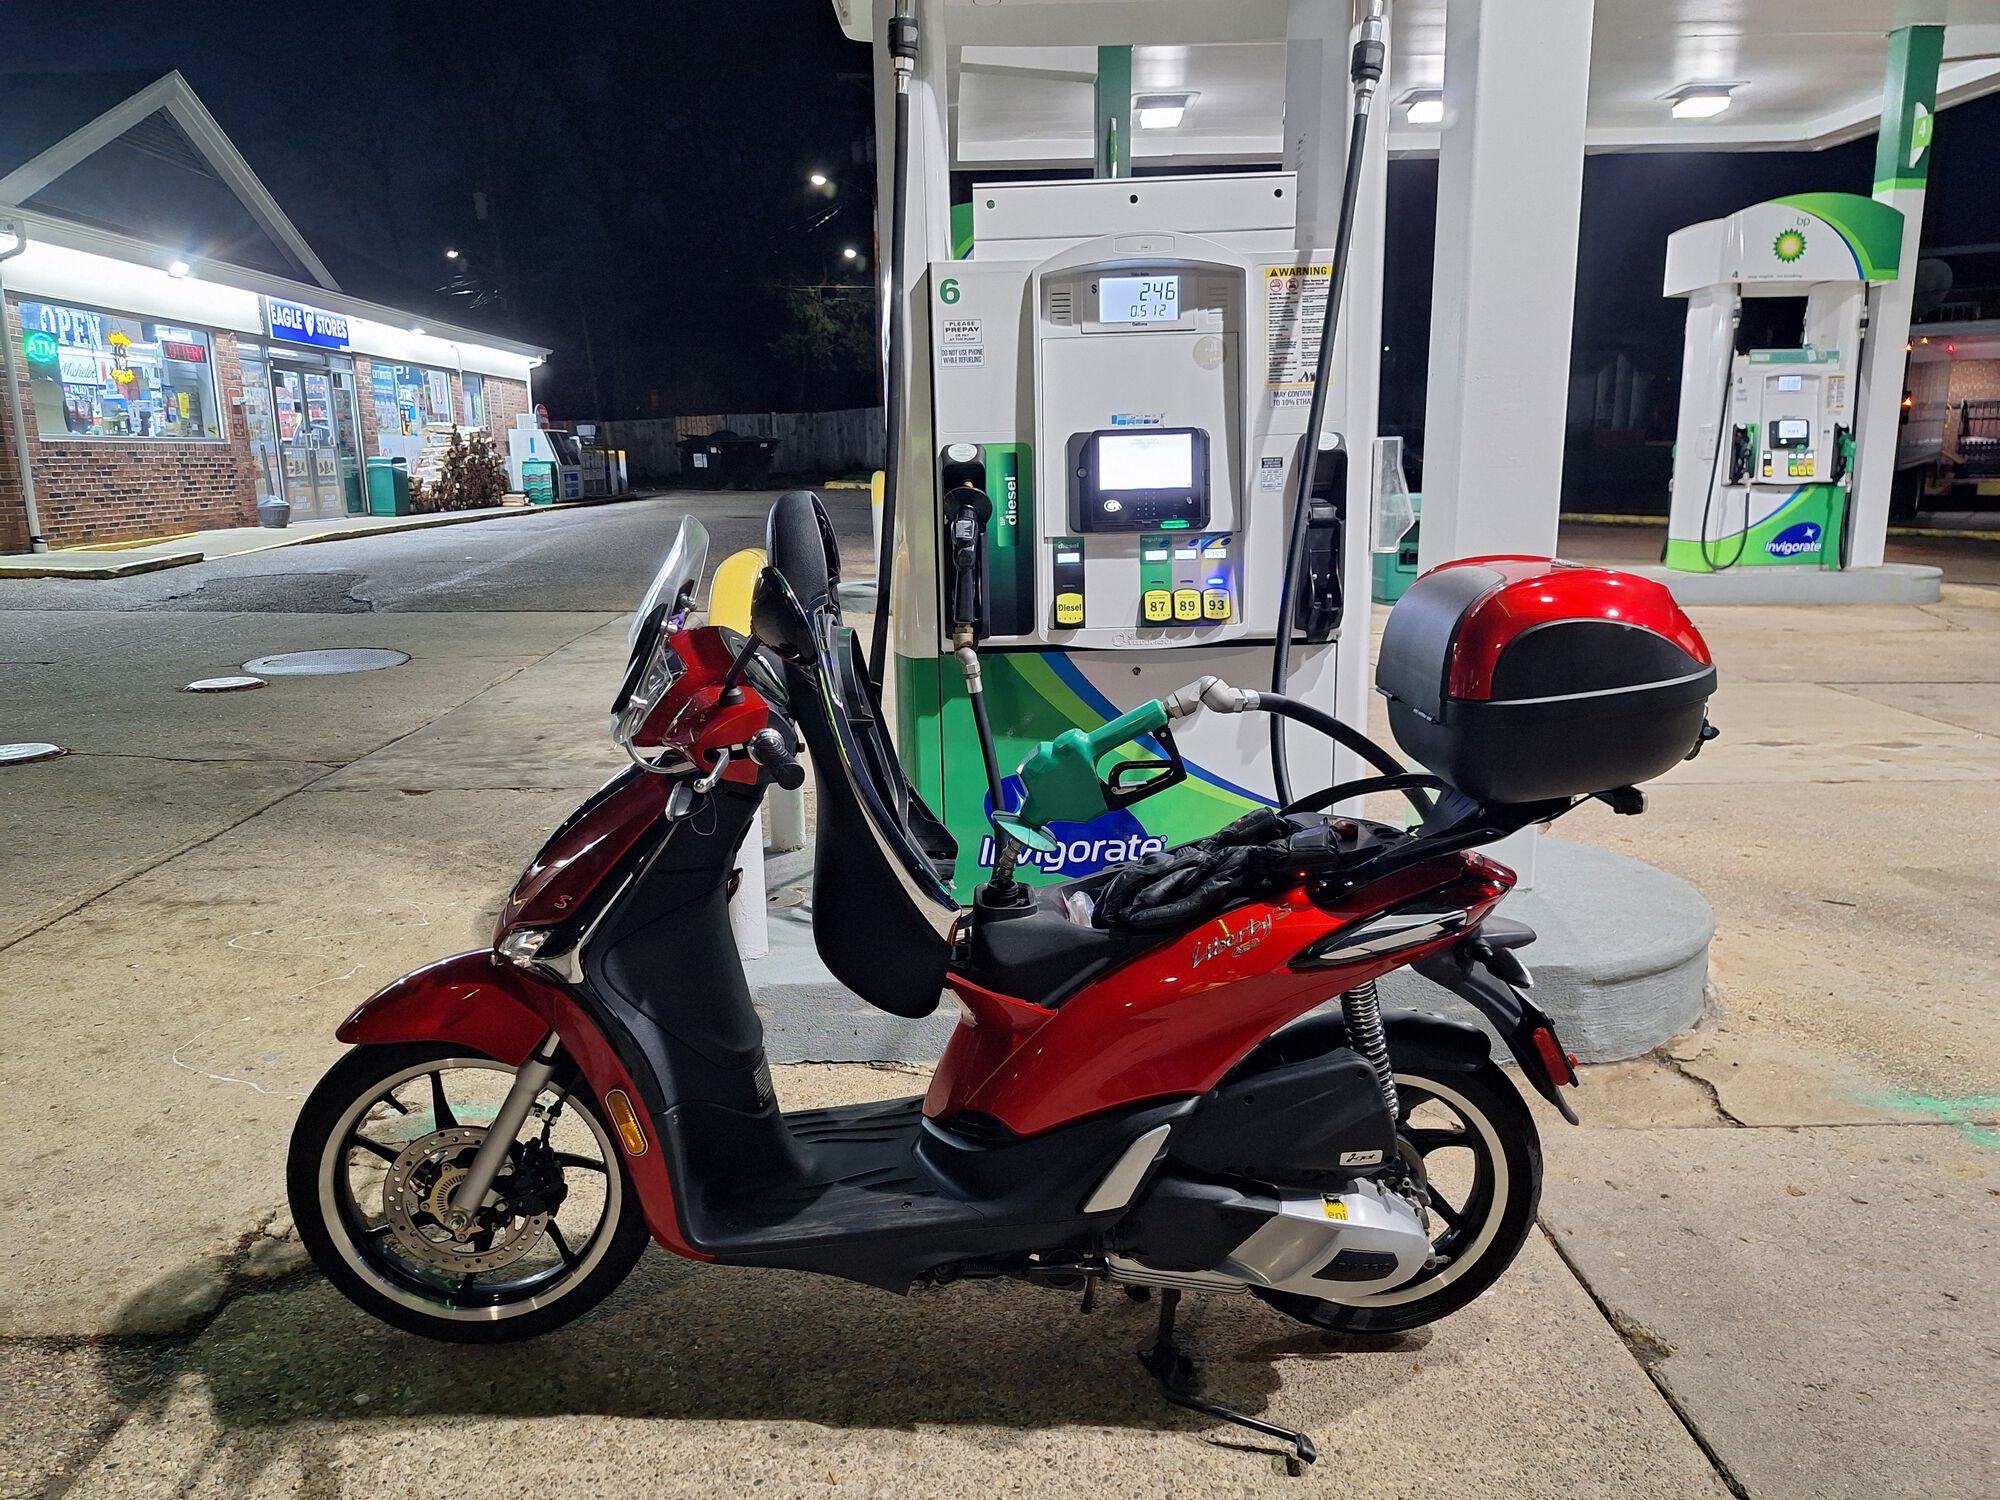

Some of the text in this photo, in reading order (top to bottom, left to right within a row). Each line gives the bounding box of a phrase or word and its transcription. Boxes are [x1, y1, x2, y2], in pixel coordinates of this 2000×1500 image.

[1918, 120, 1927, 138] 4
[1796, 216, 1811, 227] bp
[1278, 266, 1328, 277] WARNING
[1731, 270, 1739, 279] 4
[939, 278, 961, 305] 6
[1090, 284, 1098, 295] $
[1130, 303, 1167, 318] 0.512
[39, 304, 104, 350] OPEN
[270, 304, 347, 339] EAGLE STORES
[27, 340, 58, 357] ATM
[164, 341, 205, 362] LOTTERY
[949, 349, 958, 357] NOT
[968, 348, 983, 356] PHONE
[958, 356, 982, 364] REFUELING
[1287, 390, 1312, 398] CONTAIN
[1273, 399, 1281, 407] TO
[1296, 398, 1311, 406] ETHA
[1004, 476, 1017, 526] diesel
[1765, 541, 1822, 555] Invigorate
[1058, 603, 1082, 612] Diesel
[1150, 602, 1166, 612] 87
[1179, 600, 1196, 611] 89
[1208, 600, 1225, 611] 93
[554, 894, 573, 909] S
[1192, 902, 1292, 968] Liberty S
[1327, 1209, 1347, 1220] eni
